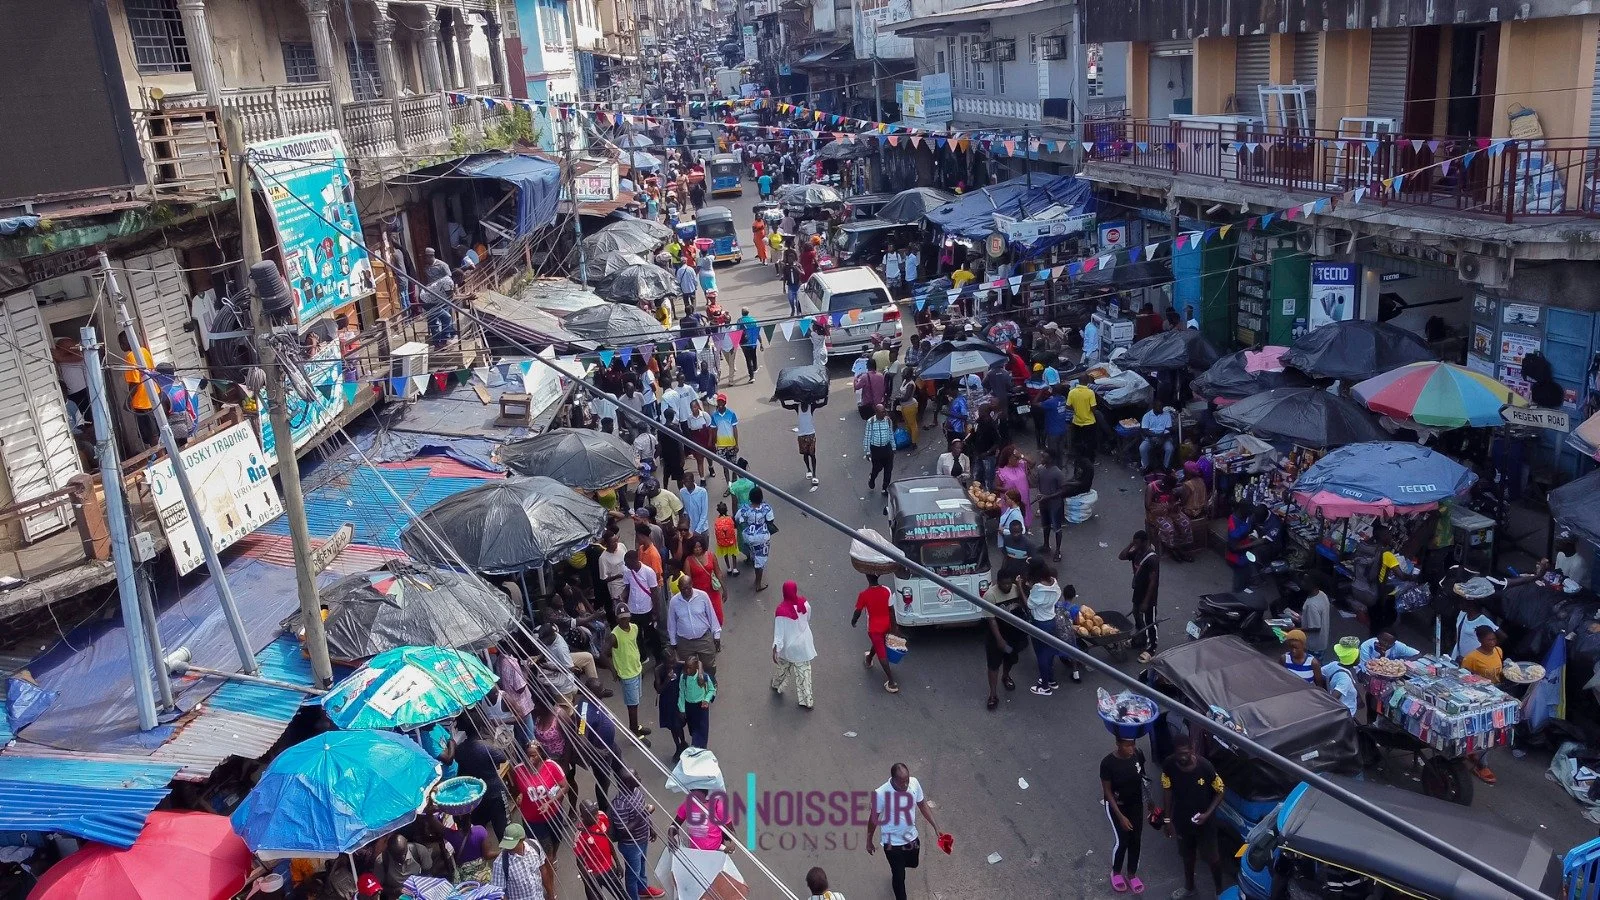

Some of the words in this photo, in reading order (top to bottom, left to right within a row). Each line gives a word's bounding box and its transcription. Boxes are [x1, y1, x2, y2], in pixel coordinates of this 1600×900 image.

[1318, 267, 1349, 280] TECNO
[1383, 273, 1400, 281] TECNO
[1513, 411, 1543, 423] REGENT
[1547, 414, 1565, 427] ROAD
[212, 427, 249, 455] TRADING
[246, 463, 268, 484] Ria
[1342, 488, 1363, 498] TECNO
[1398, 484, 1437, 493] TECNO
[161, 502, 184, 519] WESTERN
[165, 509, 188, 527] UNION
